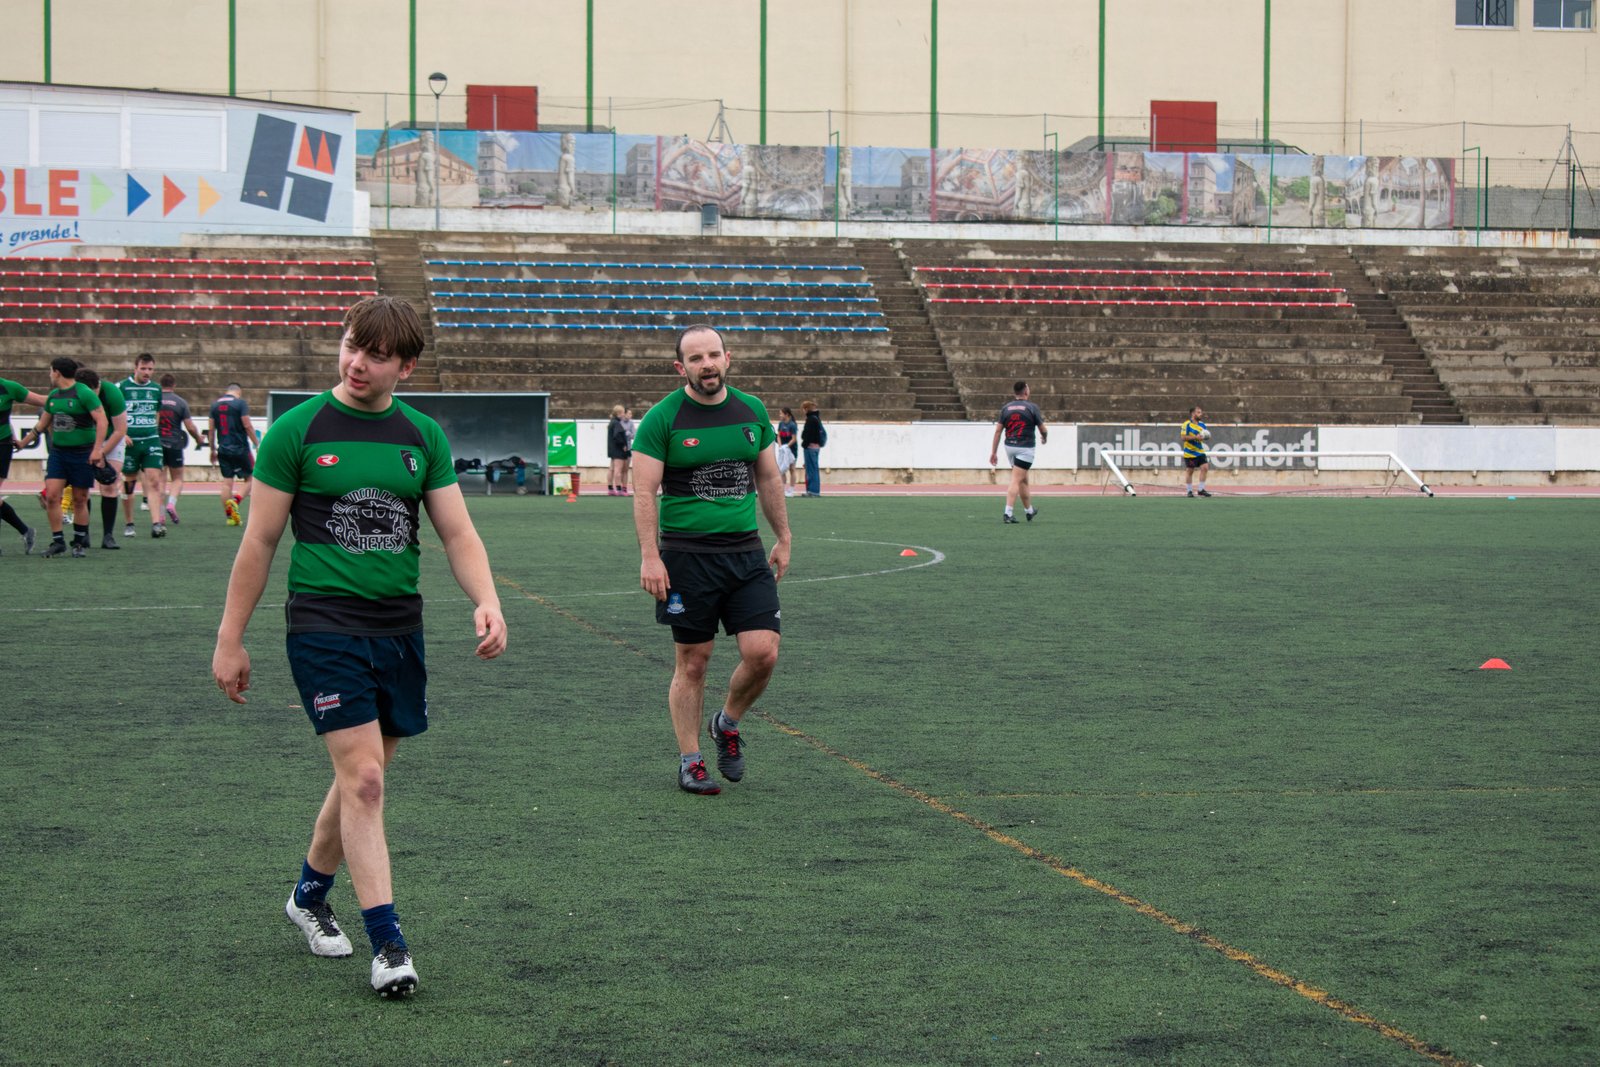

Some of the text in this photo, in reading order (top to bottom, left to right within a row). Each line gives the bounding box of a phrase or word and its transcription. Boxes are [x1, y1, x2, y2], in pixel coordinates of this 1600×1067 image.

[0, 168, 80, 216] LE
[9, 221, 80, 246] grande!
[1081, 429, 1182, 466] millan
[409, 457, 418, 472] B
[358, 535, 396, 551] REYES
